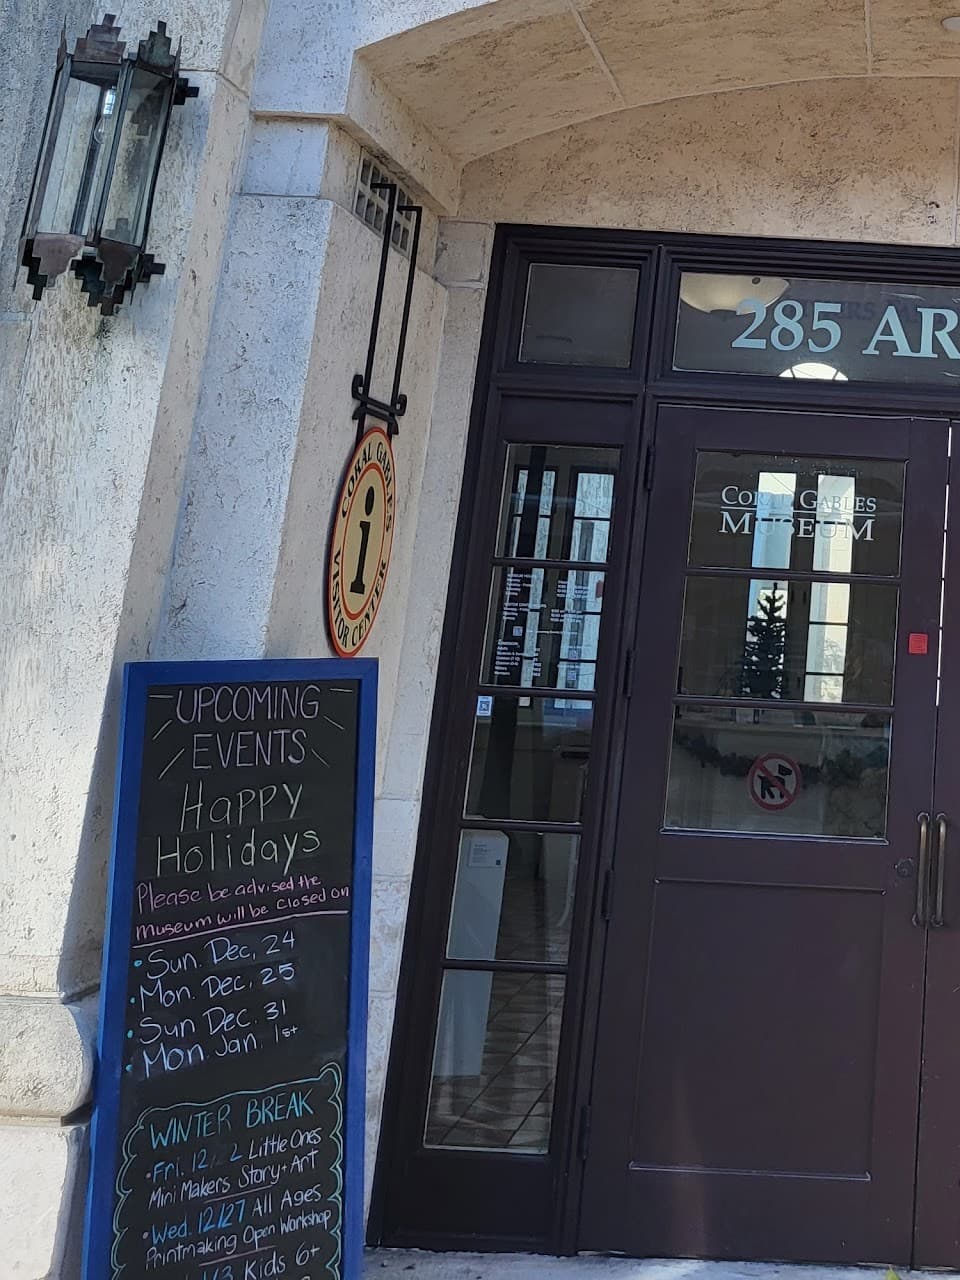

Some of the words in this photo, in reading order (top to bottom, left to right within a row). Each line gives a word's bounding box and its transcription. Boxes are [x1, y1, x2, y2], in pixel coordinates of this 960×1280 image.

[731, 298, 842, 354] 285
[800, 490, 877, 513] GABLES
[719, 511, 875, 541] MUSEUM
[176, 685, 321, 724] UPCOMING
[192, 729, 307, 770] EVENTS
[157, 829, 321, 877] Holidays
[137, 882, 200, 914] Please
[208, 883, 231, 902] be
[235, 877, 293, 897] advised
[298, 874, 321, 890] the
[217, 906, 245, 923] will
[249, 904, 269, 918] be
[331, 886, 349, 898] on
[260, 930, 296, 955] 24
[260, 963, 296, 986] 25
[264, 999, 287, 1020] 31
[150, 1104, 232, 1149] WINTER
[246, 1087, 314, 1129] BREAK
[248, 1135, 288, 1160] Little
[290, 1127, 322, 1149] Ones
[148, 1184, 176, 1210] Mini
[181, 1176, 231, 1201] Makers
[198, 1199, 246, 1233] 12/27
[252, 1197, 272, 1217] All
[280, 1184, 322, 1210] Ages
[146, 1234, 237, 1270] Printmaking
[243, 1223, 276, 1250] Open
[279, 1208, 332, 1236] Workshop
[244, 1250, 286, 1280] Kids
[295, 1241, 320, 1265] 6+
